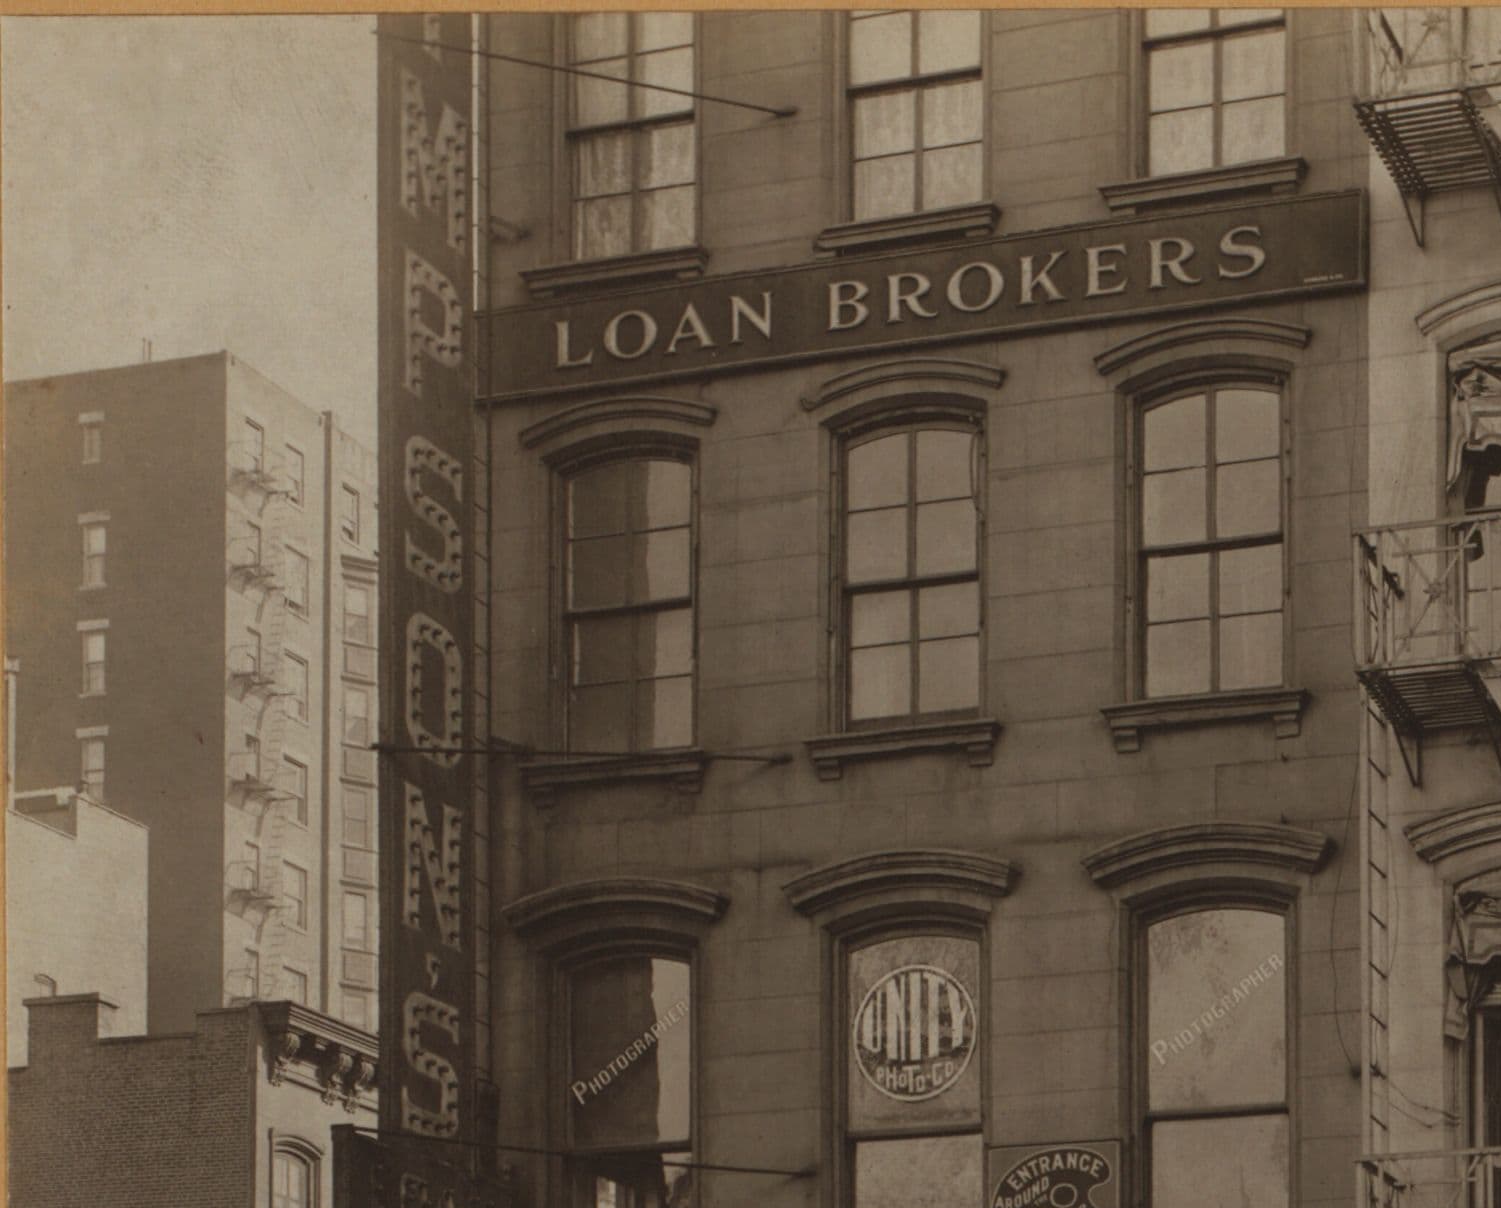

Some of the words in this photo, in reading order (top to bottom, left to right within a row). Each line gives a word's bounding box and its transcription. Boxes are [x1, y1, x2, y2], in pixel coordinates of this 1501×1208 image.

[555, 290, 773, 370] LOAN
[828, 225, 1267, 332] BROKERS
[861, 970, 969, 1062] UNITY
[1006, 1152, 1104, 1191] ENTRANCE
